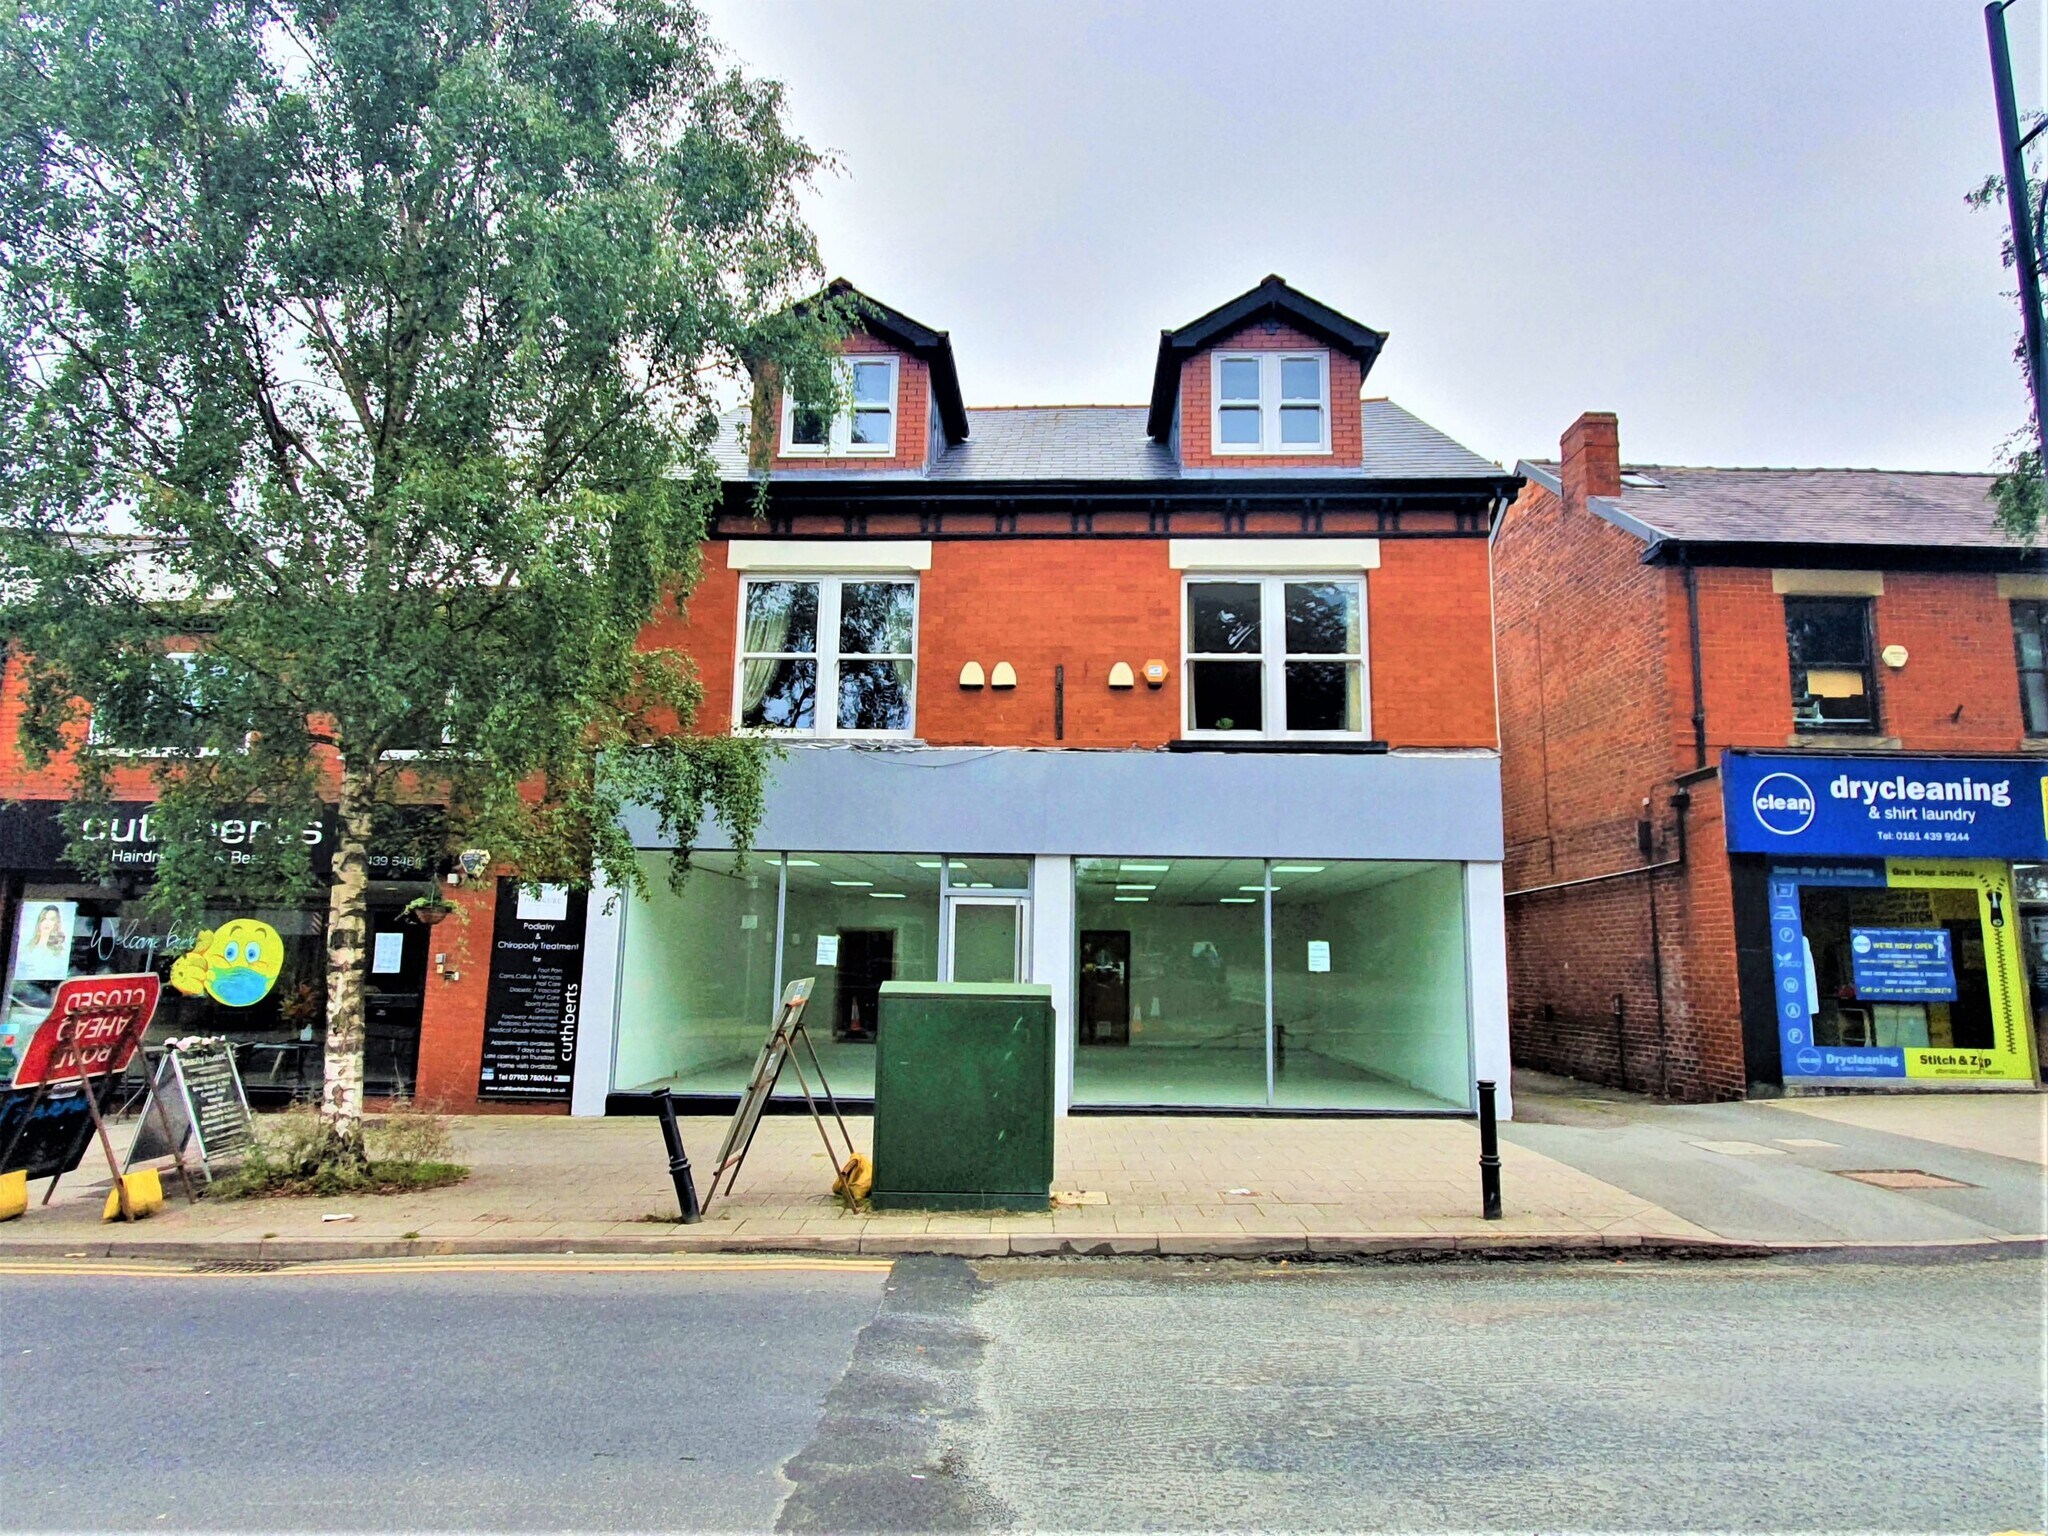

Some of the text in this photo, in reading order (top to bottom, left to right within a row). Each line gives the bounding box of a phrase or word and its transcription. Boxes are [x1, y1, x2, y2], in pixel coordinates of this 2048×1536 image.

[1830, 775, 2011, 807] drycleaning
[1756, 794, 1811, 811] clean
[1868, 806, 1976, 824] & shirt laundry
[82, 814, 323, 845] cuters
[1877, 831, 1970, 841] Tel: 0161 439 9244
[523, 922, 555, 932] Podiatry
[90, 918, 160, 960] Welcome
[535, 932, 541, 940] &
[497, 941, 580, 951] Chiropody Treatment
[532, 955, 542, 963] for
[64, 987, 146, 1016] CLOSED
[559, 983, 579, 1062] cuthberts
[1825, 1053, 1899, 1067] Drycleaning
[1919, 1054, 1956, 1066] Stitch
[1959, 1056, 1968, 1066] &
